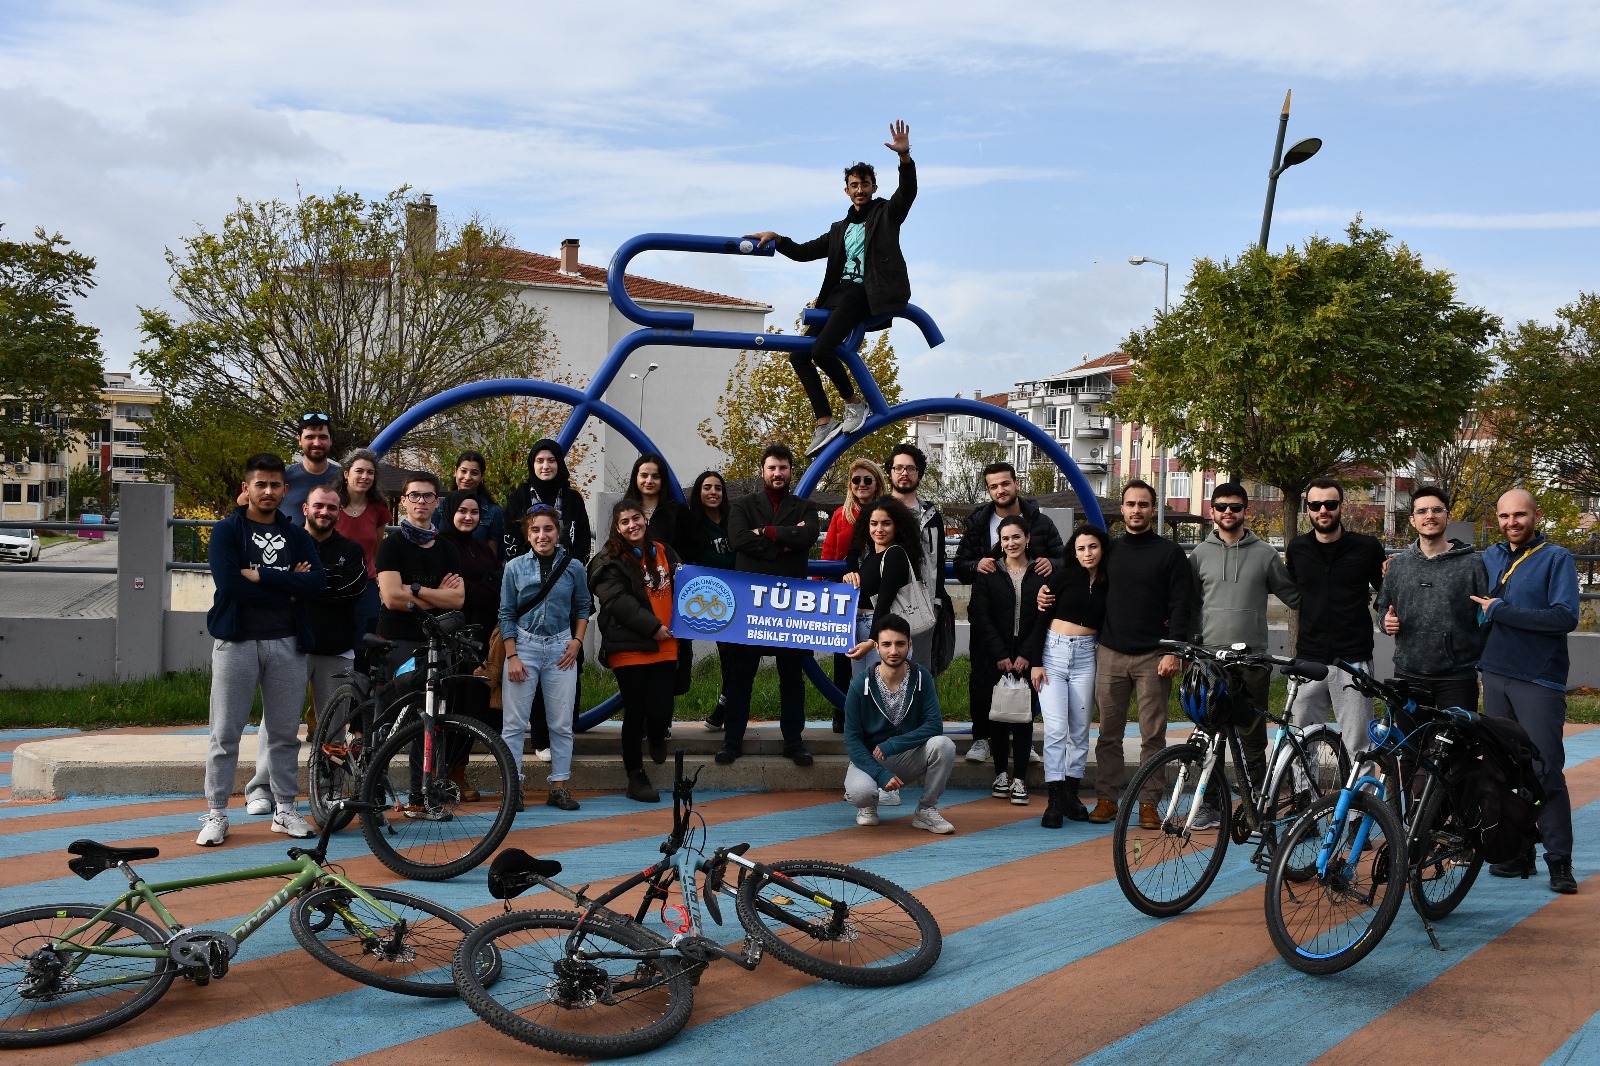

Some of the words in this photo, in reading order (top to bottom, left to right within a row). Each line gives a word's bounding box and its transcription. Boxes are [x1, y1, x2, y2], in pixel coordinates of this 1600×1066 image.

[750, 581, 851, 615] TÜBİT
[746, 614, 784, 628] TRAKYA
[785, 616, 852, 634] ÜNİVERSİTESİ
[747, 627, 790, 642] BİSİKLET
[791, 633, 848, 647] TOPLULUĞU
